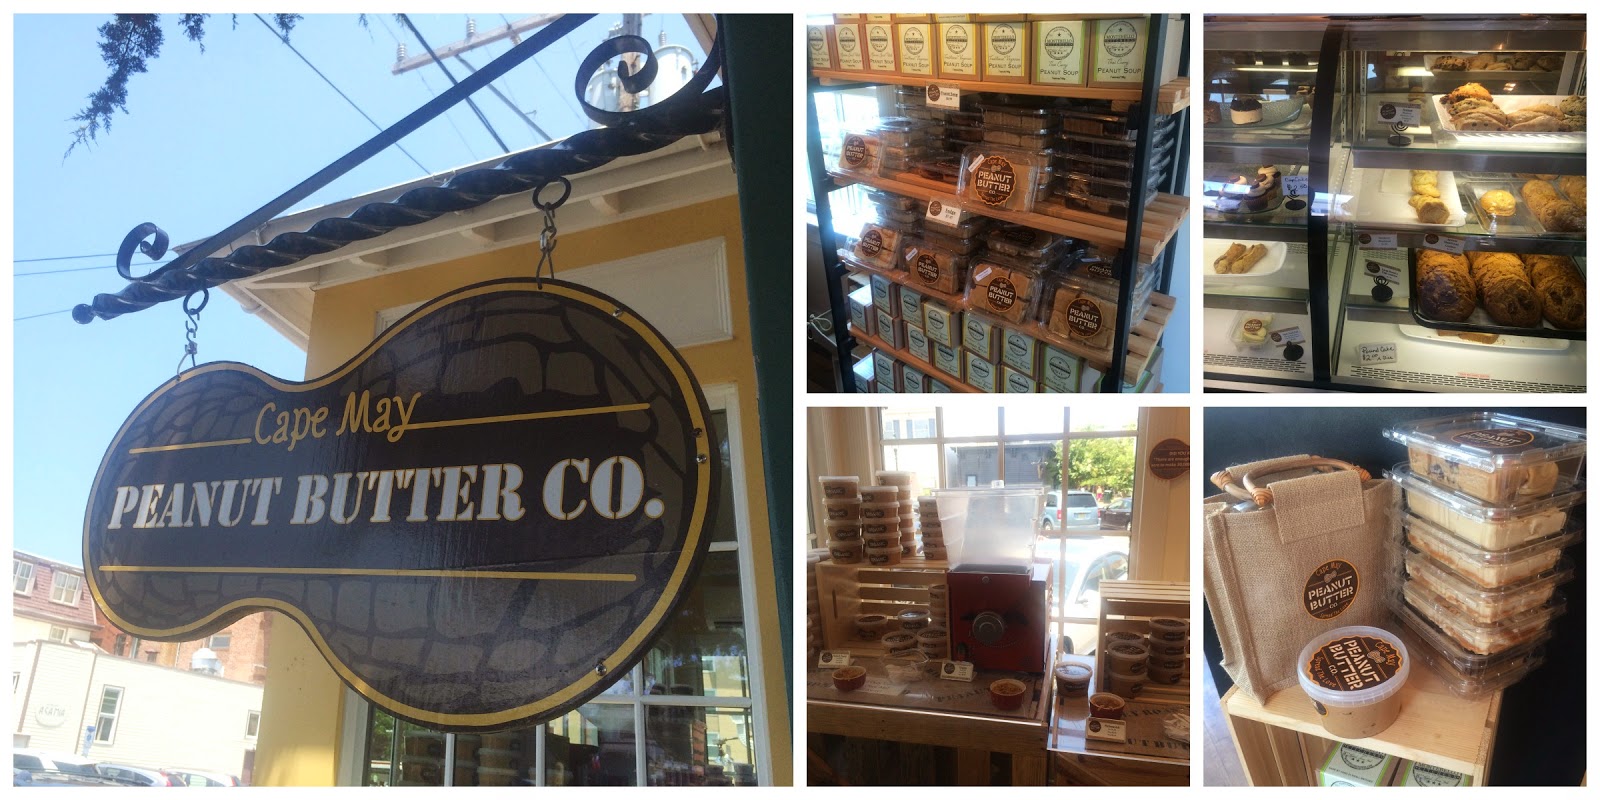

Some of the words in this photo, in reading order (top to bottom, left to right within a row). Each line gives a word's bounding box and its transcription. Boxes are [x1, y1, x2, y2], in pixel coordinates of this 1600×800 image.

[978, 171, 1012, 183] PEANUT
[977, 180, 1010, 192] BUTTER
[988, 292, 1012, 305] BUTTER
[990, 285, 1014, 298] PEANUT
[1069, 315, 1097, 330] BUTTER
[1070, 308, 1098, 322] PEANUT
[254, 402, 329, 452] Cape
[336, 390, 422, 442] May
[108, 476, 283, 530] PEANUT
[290, 463, 526, 525] BUTTER
[542, 456, 665, 521] CO.
[1308, 576, 1353, 600] PEANUT
[1310, 586, 1353, 610] BUTTER
[1375, 642, 1390, 653] Cape
[1329, 644, 1363, 690] BUTTER
[1344, 640, 1380, 682] PEANUT
